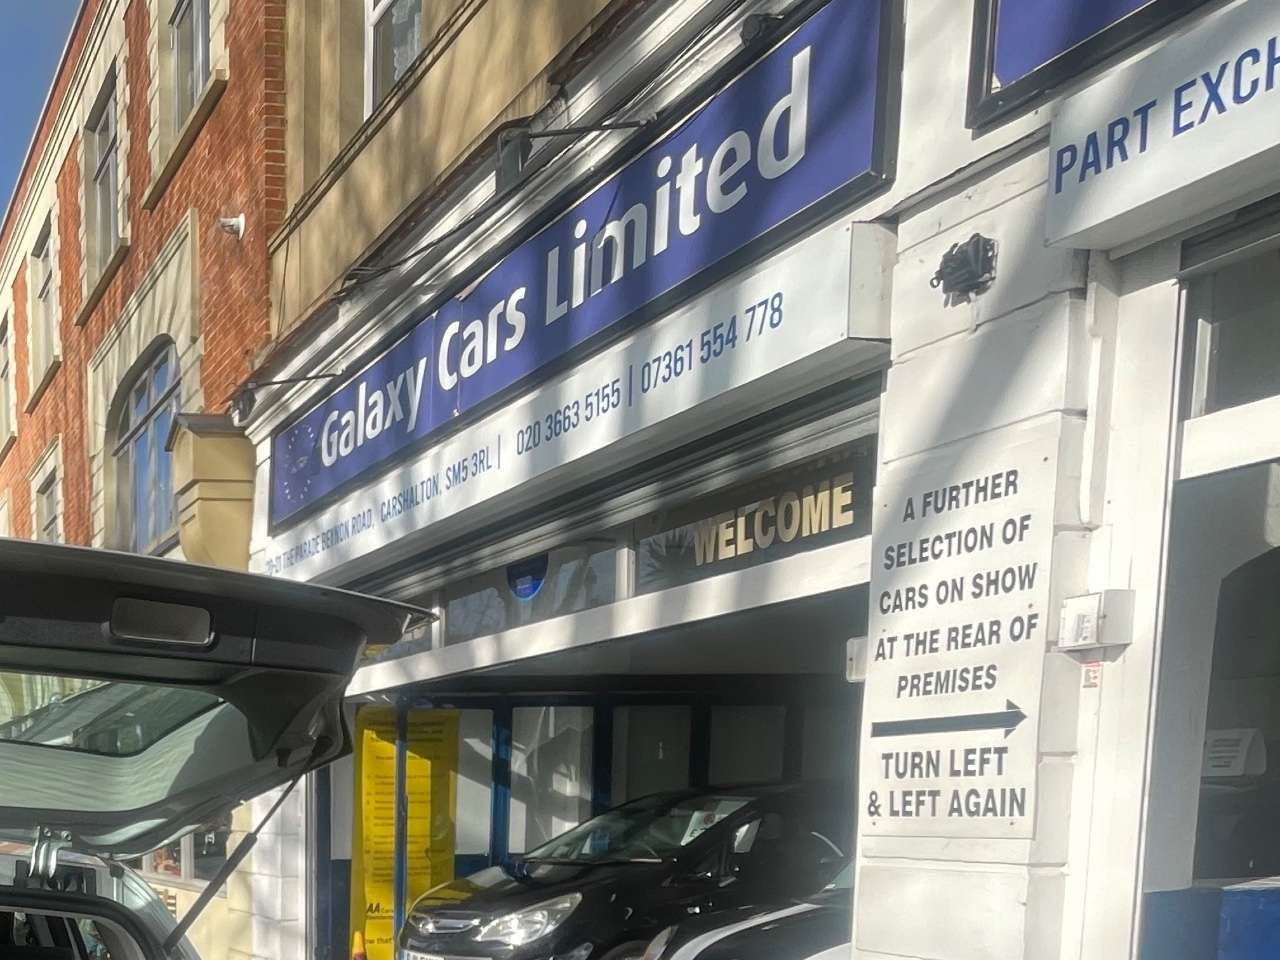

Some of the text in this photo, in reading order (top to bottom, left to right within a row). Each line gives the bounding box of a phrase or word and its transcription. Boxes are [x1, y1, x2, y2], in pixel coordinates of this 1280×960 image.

[1055, 99, 1157, 195] PART
[320, 45, 812, 467] Galaxy Cars Limited
[446, 457, 468, 490] SM5
[471, 446, 492, 477] 3RL
[516, 420, 541, 455] 020
[545, 400, 580, 441] 3663
[585, 378, 621, 421] 5155
[641, 339, 693, 394] 07361
[700, 315, 737, 364] 554
[745, 292, 784, 343] 778
[693, 472, 854, 567] WELCOME
[902, 469, 1018, 522] A FURTHER
[884, 514, 1032, 570] SELECTION OF
[879, 562, 1038, 615] CARS ON SHOW
[874, 613, 1039, 661] AT THE REAR OF
[896, 664, 998, 699] PREMISES
[881, 747, 1008, 779] TURN LEFT
[867, 788, 1026, 817] & LEFT AGAIN
